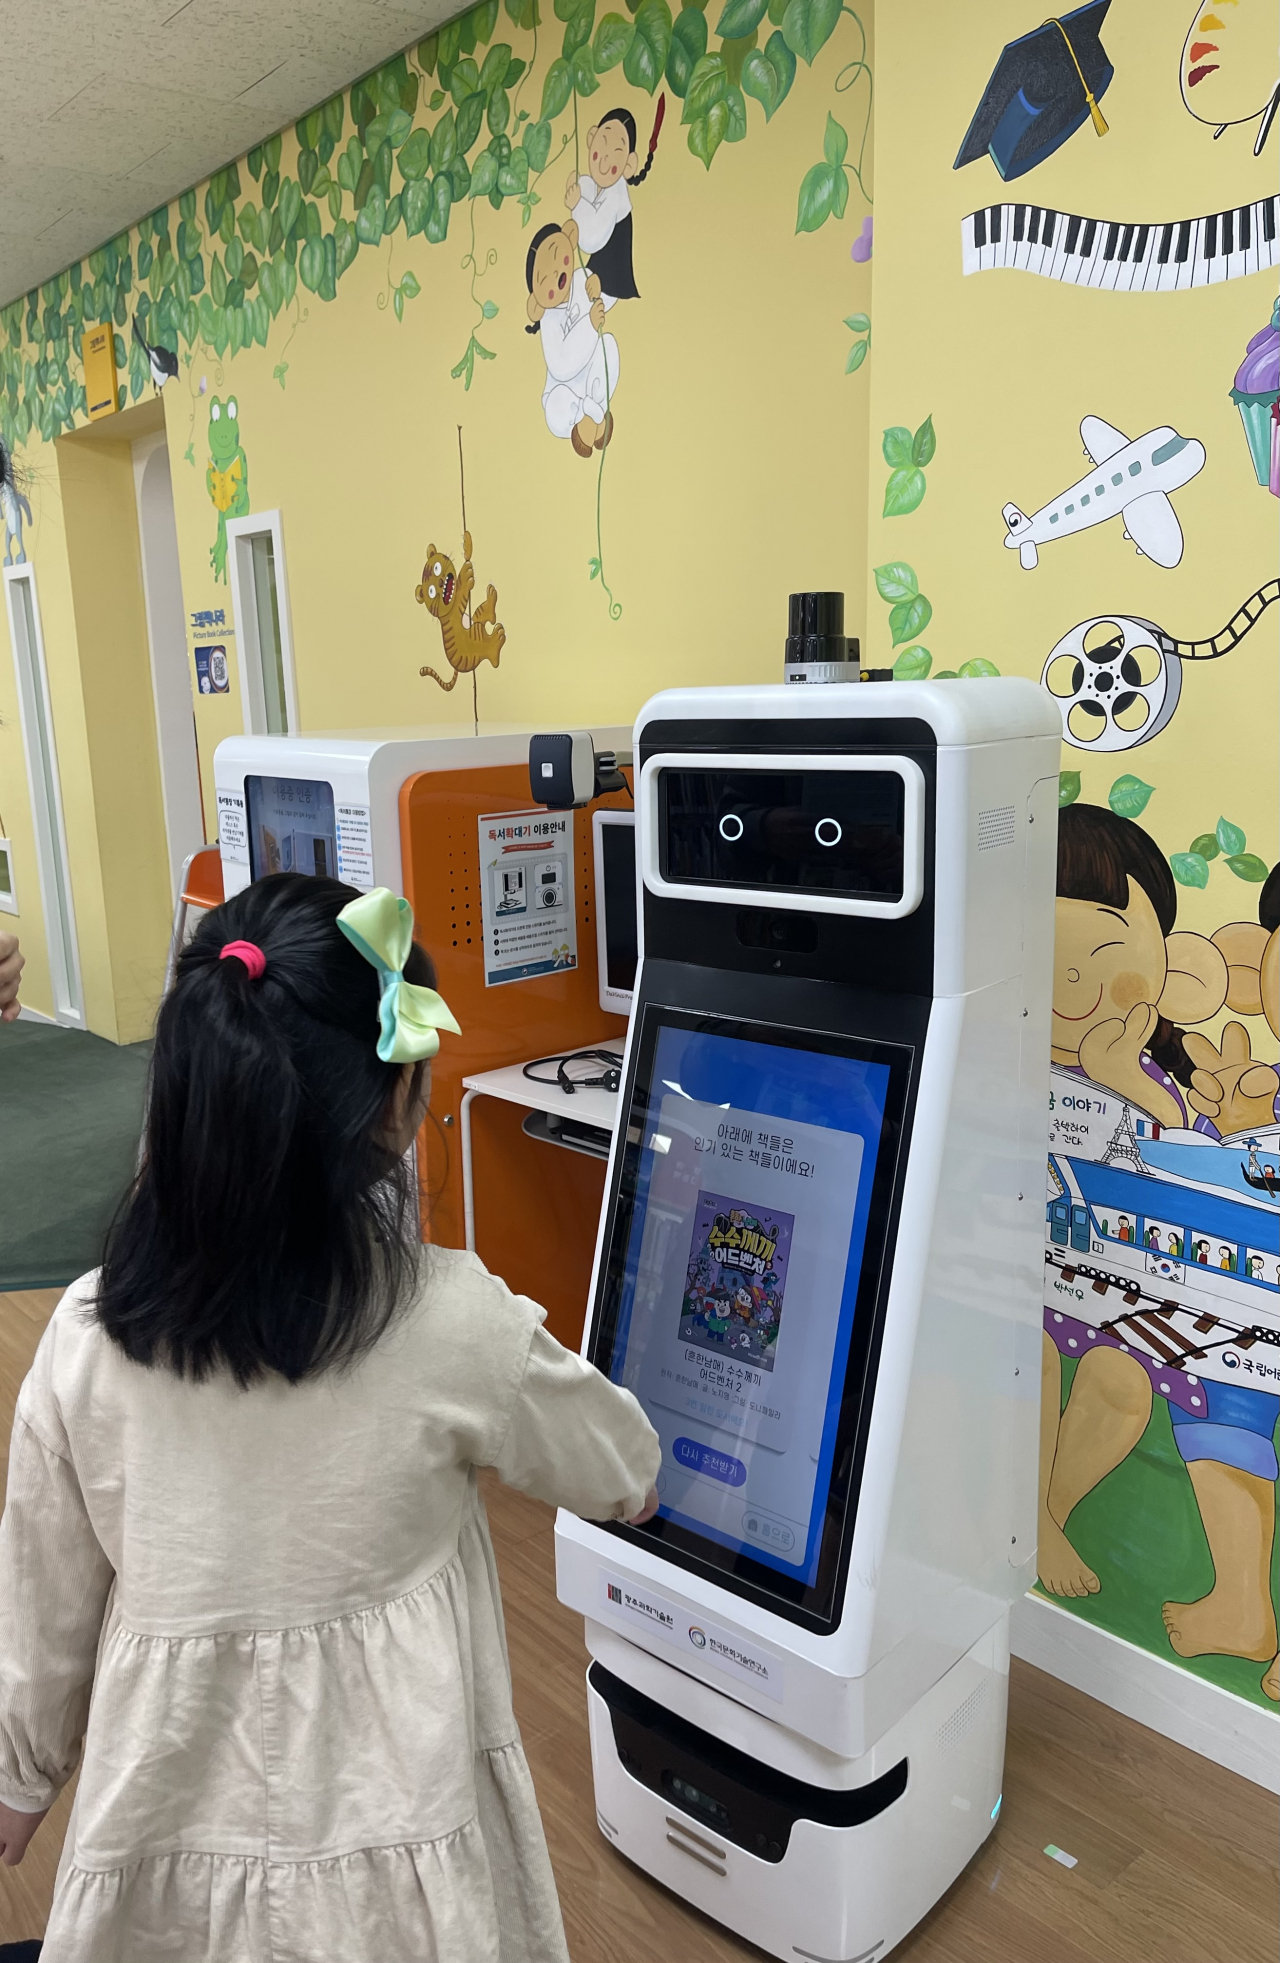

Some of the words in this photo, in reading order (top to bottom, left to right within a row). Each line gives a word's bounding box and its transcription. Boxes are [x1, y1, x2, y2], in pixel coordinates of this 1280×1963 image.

[272, 784, 294, 802] 이용증
[296, 786, 312, 804] 인증
[488, 825, 531, 841] 독서확대기
[533, 820, 566, 836] 이용안내
[1062, 1096, 1106, 1115] 이야기
[717, 1123, 753, 1145] 아래에
[757, 1132, 794, 1155] 책들은
[694, 1136, 717, 1155] 인기
[721, 1142, 744, 1162] 있는
[748, 1149, 815, 1178] 책들이에요!
[708, 1225, 777, 1262] 수수께끼
[715, 1247, 766, 1275] 어드벤처
[675, 1374, 699, 1390] 흔한남매
[684, 1348, 725, 1374] (흔한남매)
[727, 1365, 762, 1387] 수수께끼
[699, 1368, 734, 1390] 어드벤처
[736, 1382, 742, 1393] 2
[681, 1444, 699, 1462] 다시
[701, 1453, 738, 1478] 추천받기
[761, 1523, 791, 1545] 홈으로
[624, 1594, 674, 1626] 광주과학기술원
[709, 1638, 769, 1676] 한국문화기술연구소
